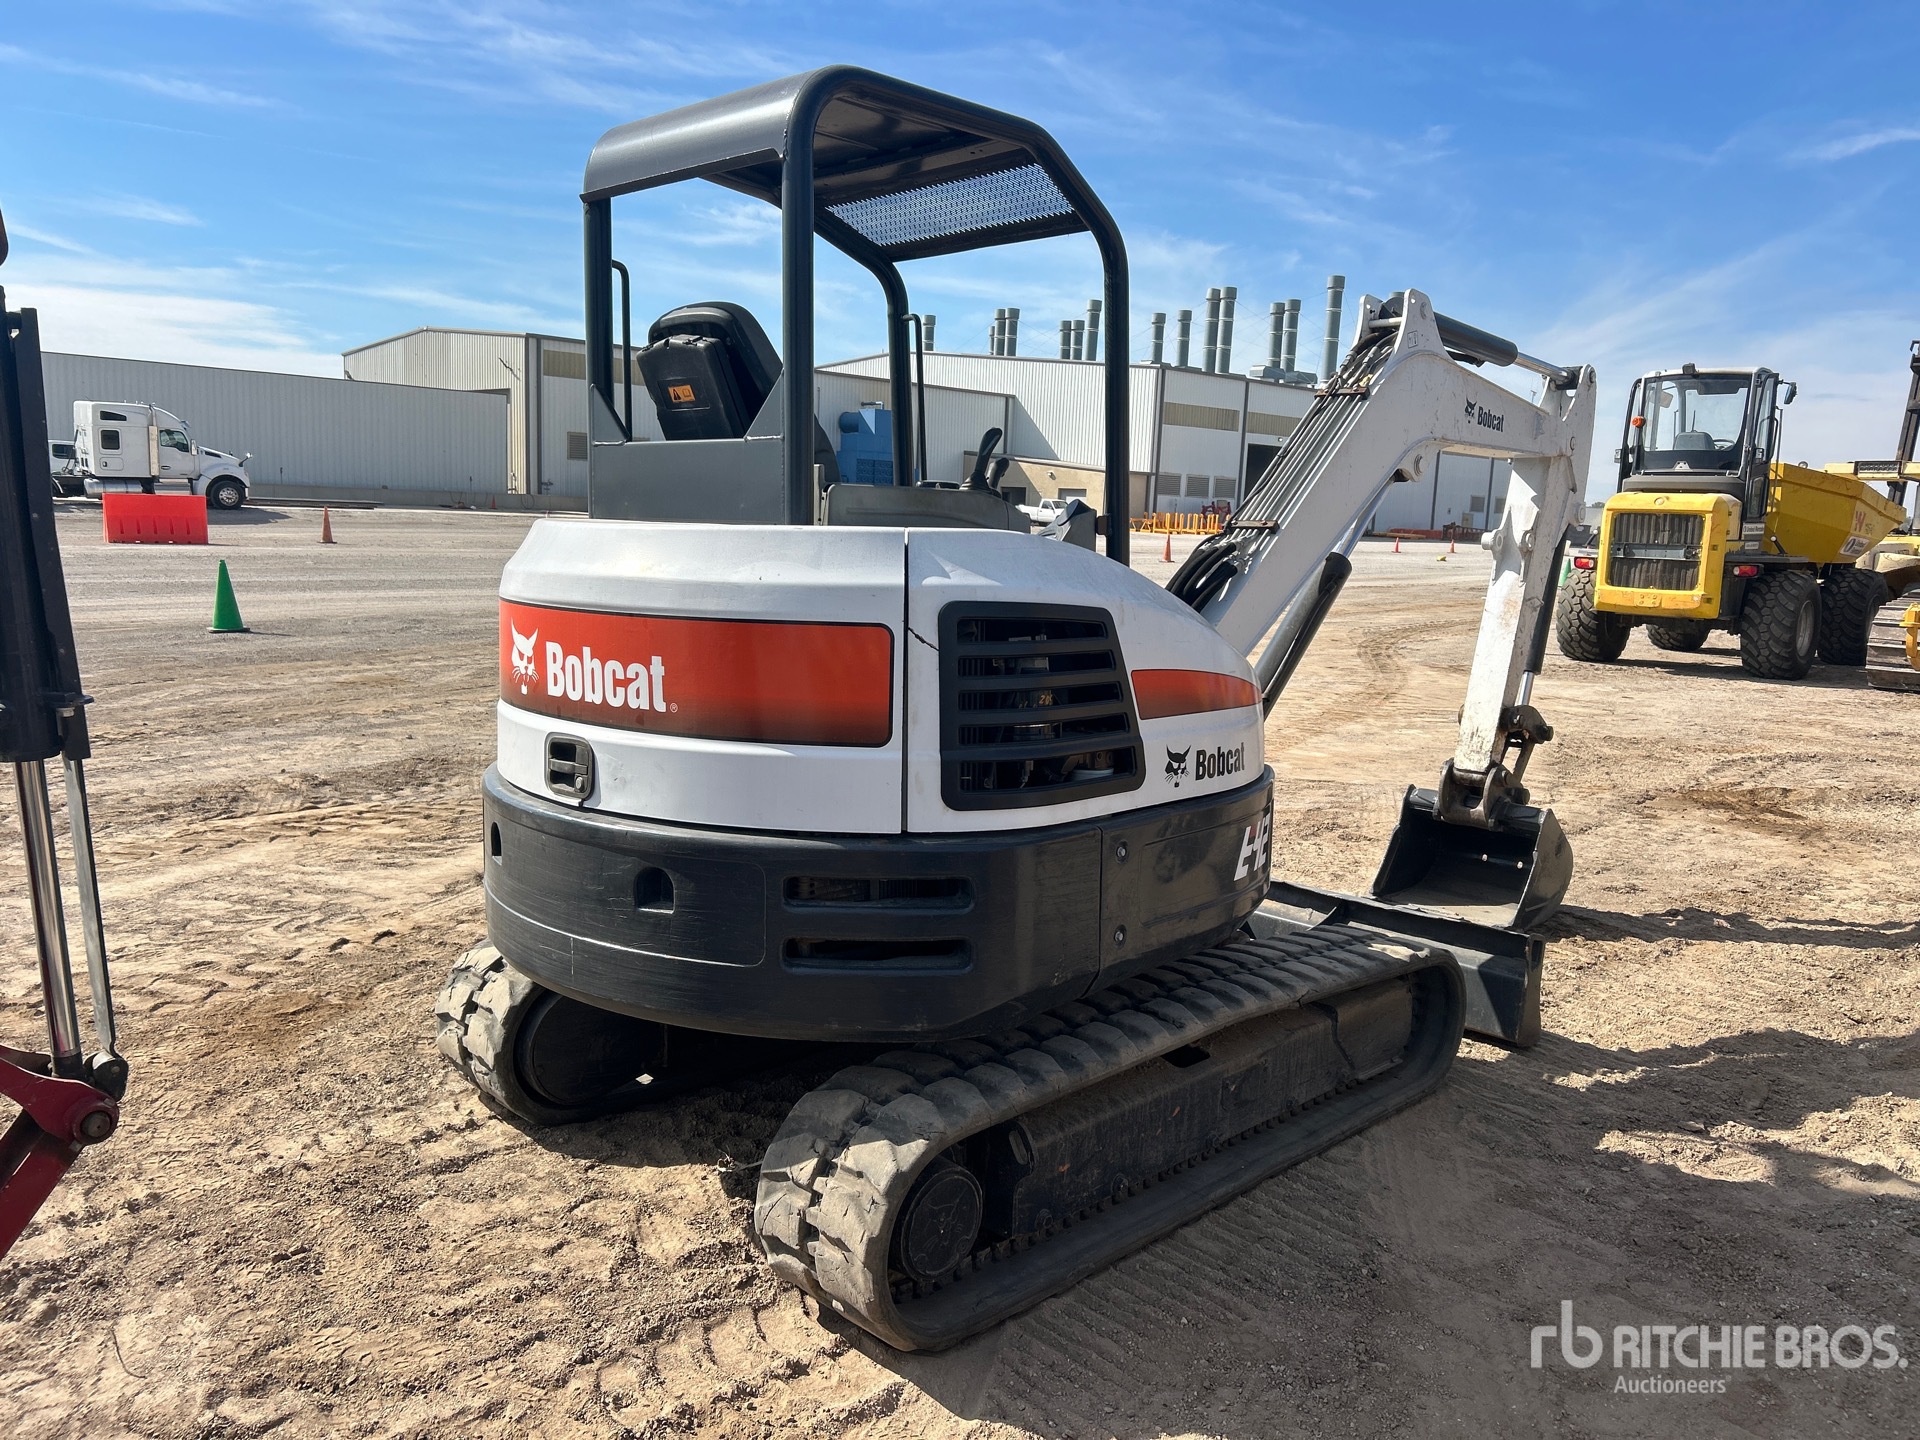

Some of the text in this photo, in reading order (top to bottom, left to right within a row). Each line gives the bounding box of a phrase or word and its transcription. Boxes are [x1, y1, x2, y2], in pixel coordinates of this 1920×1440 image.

[1477, 406, 1504, 432] Bobcat
[545, 641, 667, 713] Bobcat
[1195, 742, 1245, 781] Bobcat
